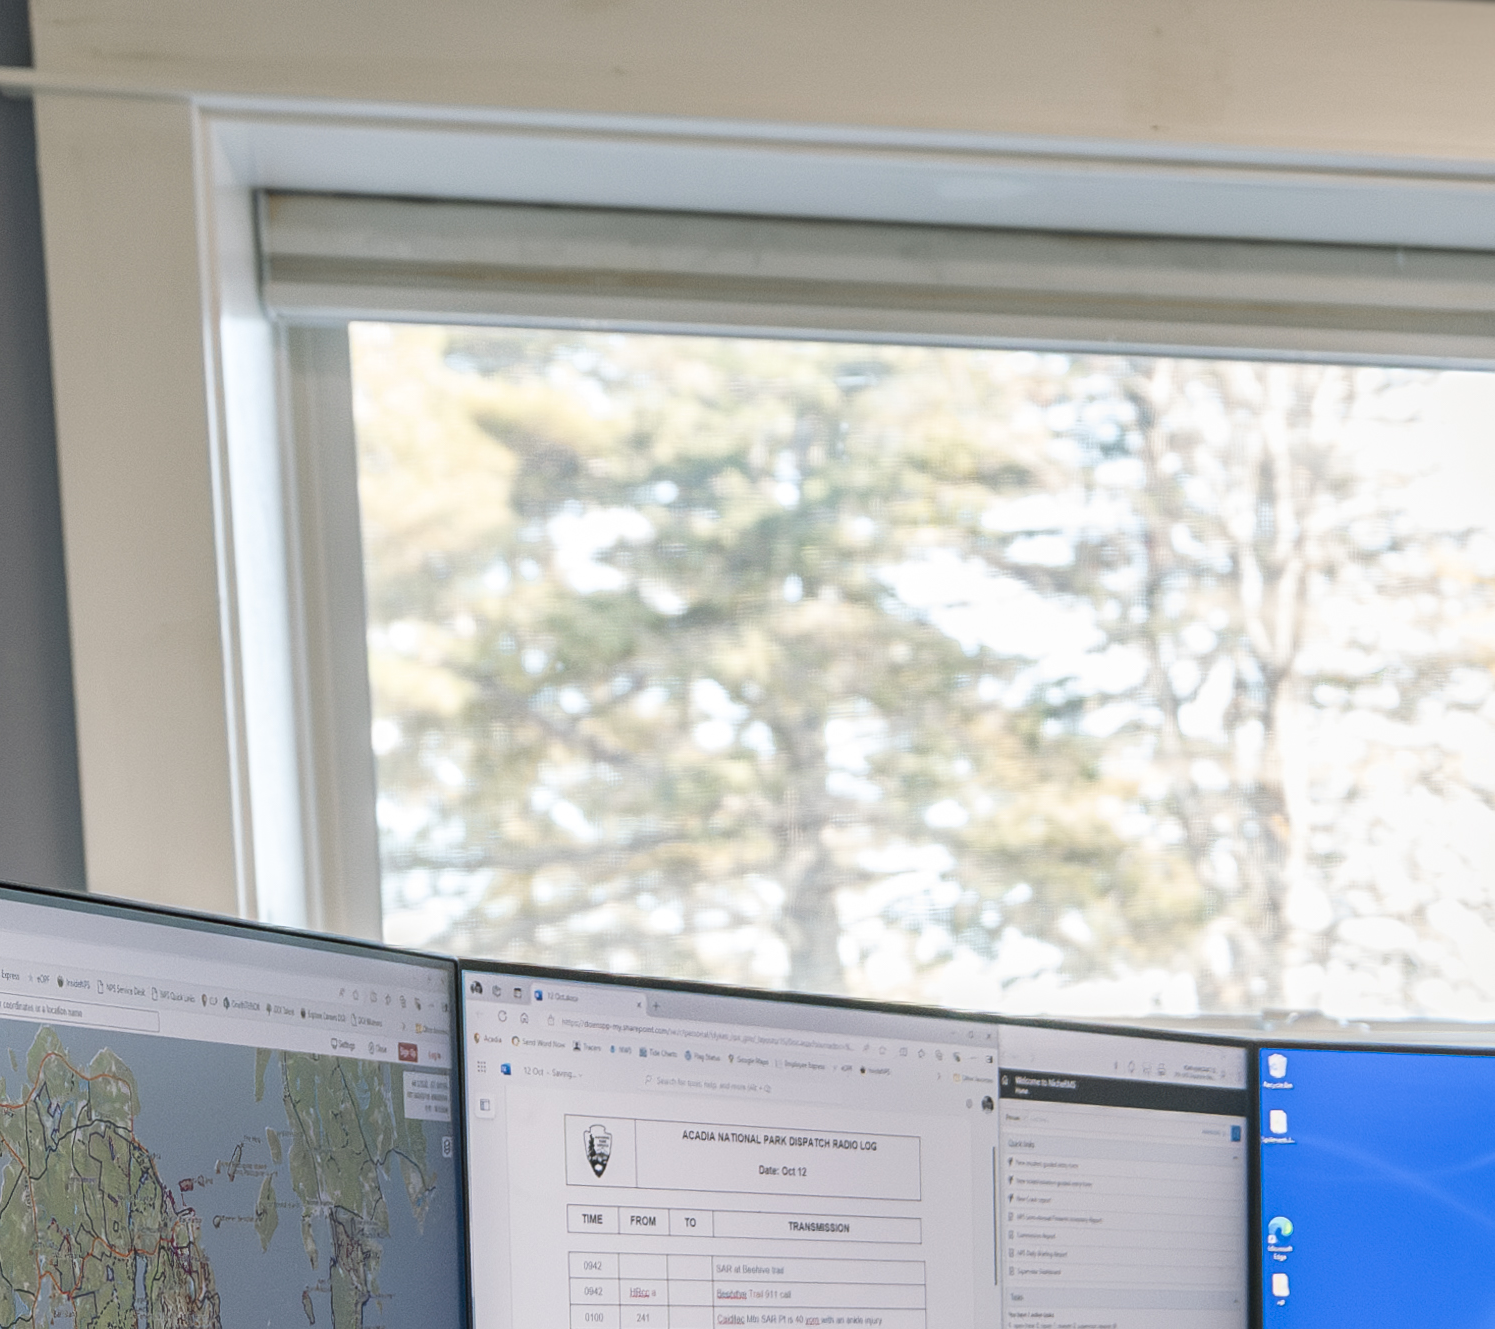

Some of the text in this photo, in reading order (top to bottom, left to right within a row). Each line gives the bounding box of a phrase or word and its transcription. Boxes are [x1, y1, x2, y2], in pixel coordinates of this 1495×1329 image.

[523, 1066, 532, 1076] 12
[532, 1067, 544, 1077] Oct
[682, 1130, 878, 1151] ACADIA NATIONAL PARK DISPATCH RADIO LOG
[758, 1165, 808, 1177] Date: Oct 12
[581, 1213, 850, 1233] TIME FROM TO TRANSMISSION
[583, 1261, 603, 1272] 0942
[715, 1264, 733, 1274] SAR
[583, 1286, 792, 1299] 0942 Trail 911 call
[584, 1312, 604, 1323] 0100
[636, 1312, 650, 1323] 241
[761, 1314, 777, 1325] SAR
[795, 1315, 804, 1324] 40
[821, 1316, 834, 1325] with
